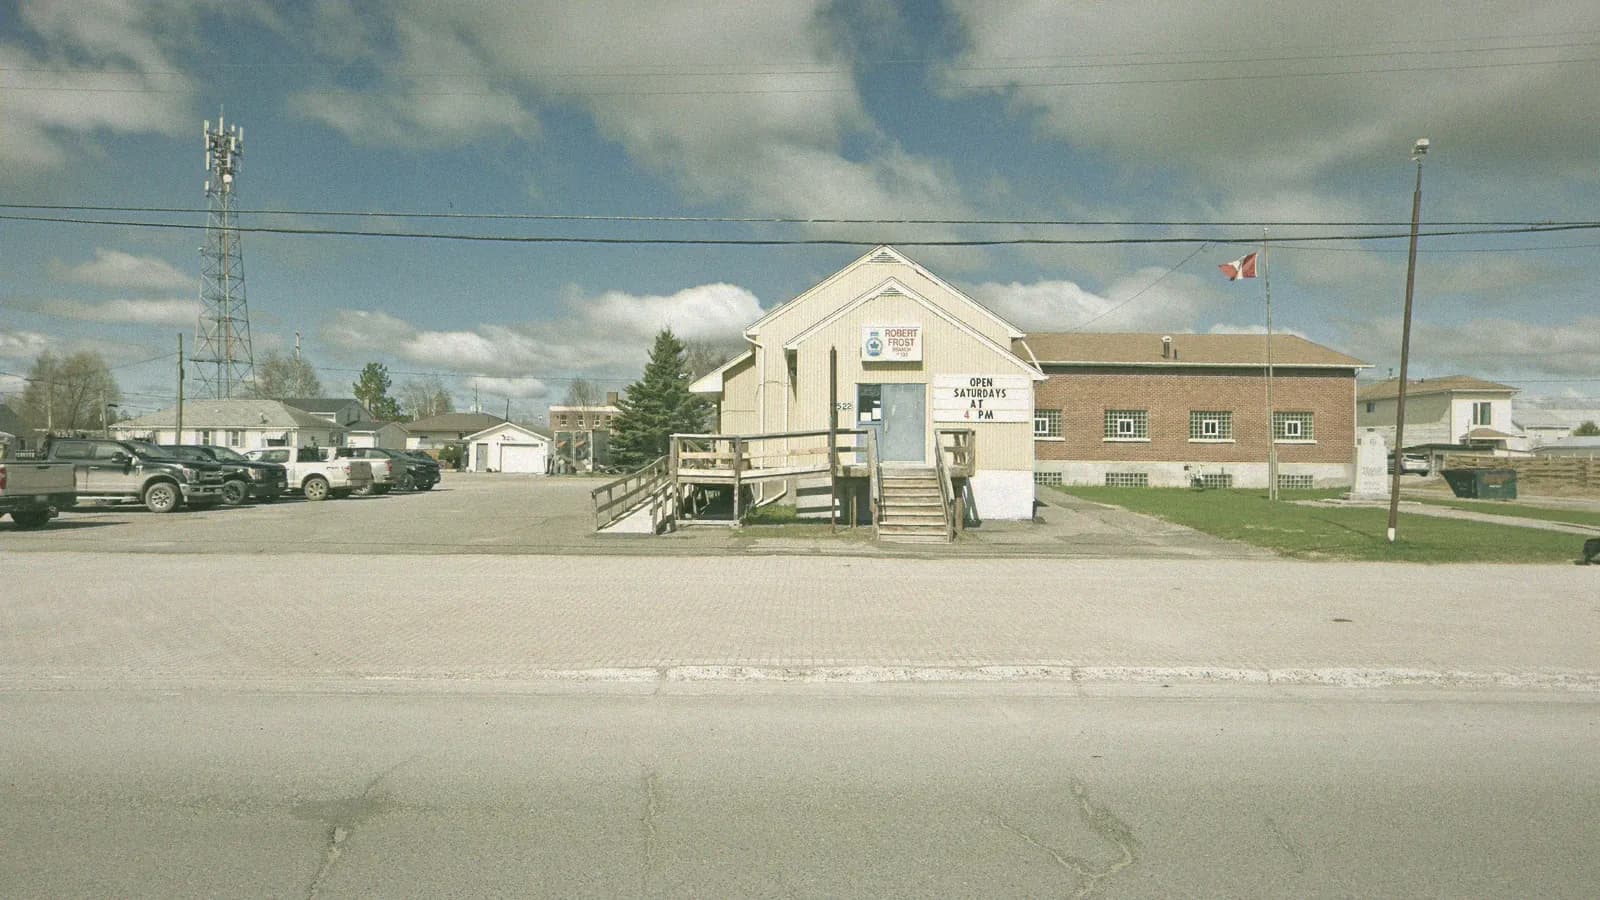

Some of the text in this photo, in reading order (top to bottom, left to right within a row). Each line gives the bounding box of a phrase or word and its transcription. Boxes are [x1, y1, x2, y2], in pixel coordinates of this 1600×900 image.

[885, 329, 918, 337] ROBERT
[888, 338, 915, 346] FROST
[970, 378, 993, 387] OPEN
[954, 388, 1006, 398] SATURDAYS
[970, 399, 983, 408] AT
[964, 410, 993, 419] 4 PM
